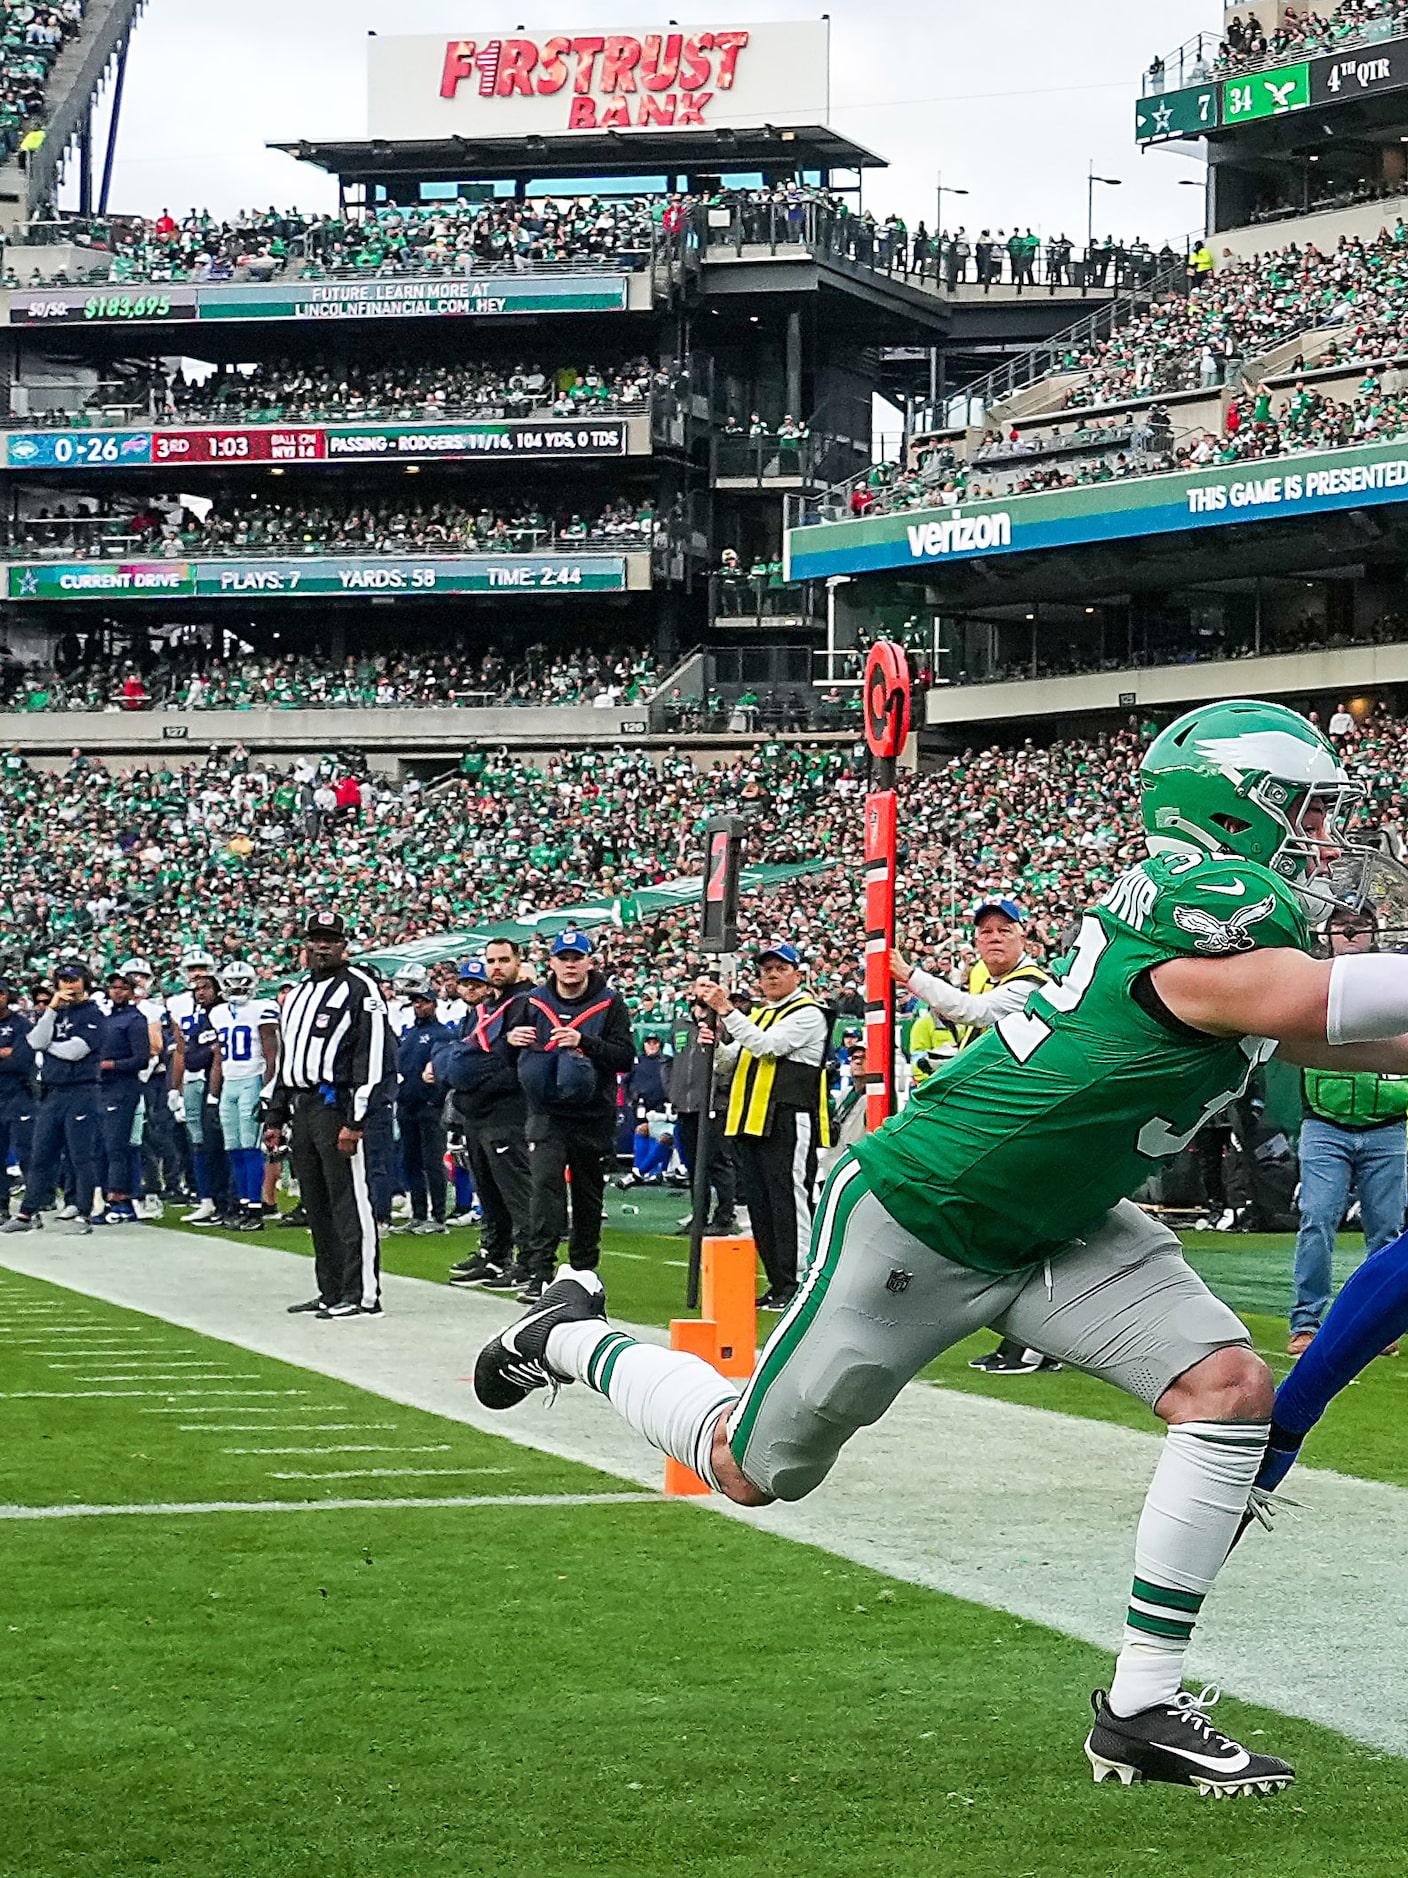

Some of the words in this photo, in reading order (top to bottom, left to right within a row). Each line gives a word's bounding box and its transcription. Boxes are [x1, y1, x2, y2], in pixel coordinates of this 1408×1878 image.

[1326, 60, 1355, 92] 4TH
[1356, 57, 1391, 87] QTR
[567, 92, 713, 130] BANK
[1197, 94, 1211, 121] 7
[1229, 85, 1252, 114] 34
[311, 286, 372, 301] FUTURE.
[376, 284, 423, 300] LEARN
[427, 282, 469, 298] MORE
[472, 282, 490, 297] AT
[84, 295, 171, 319] $183,695
[475, 297, 506, 313] HEY
[54, 437, 70, 462] 0
[87, 437, 120, 462] 26
[156, 437, 190, 459] 3RD
[208, 436, 249, 457] 1:03
[330, 435, 388, 452] PASSING
[516, 431, 542, 449] 104
[545, 431, 576, 449] YDS,
[590, 430, 619, 447] TDS
[1186, 486, 1228, 513] THIS
[1229, 477, 1282, 508] GAME
[1284, 475, 1303, 500] IS
[907, 508, 1011, 558] verizon
[59, 573, 132, 590] CURRENT
[134, 572, 181, 588] DRIVE
[220, 570, 285, 590] PLAYS:
[289, 570, 302, 588] 7
[338, 569, 407, 588] YARDS:
[410, 568, 436, 587] 58
[487, 567, 535, 587] TIME:
[541, 567, 582, 587] 2:44
[707, 832, 728, 901] 2
[996, 913, 1110, 1066] 2
